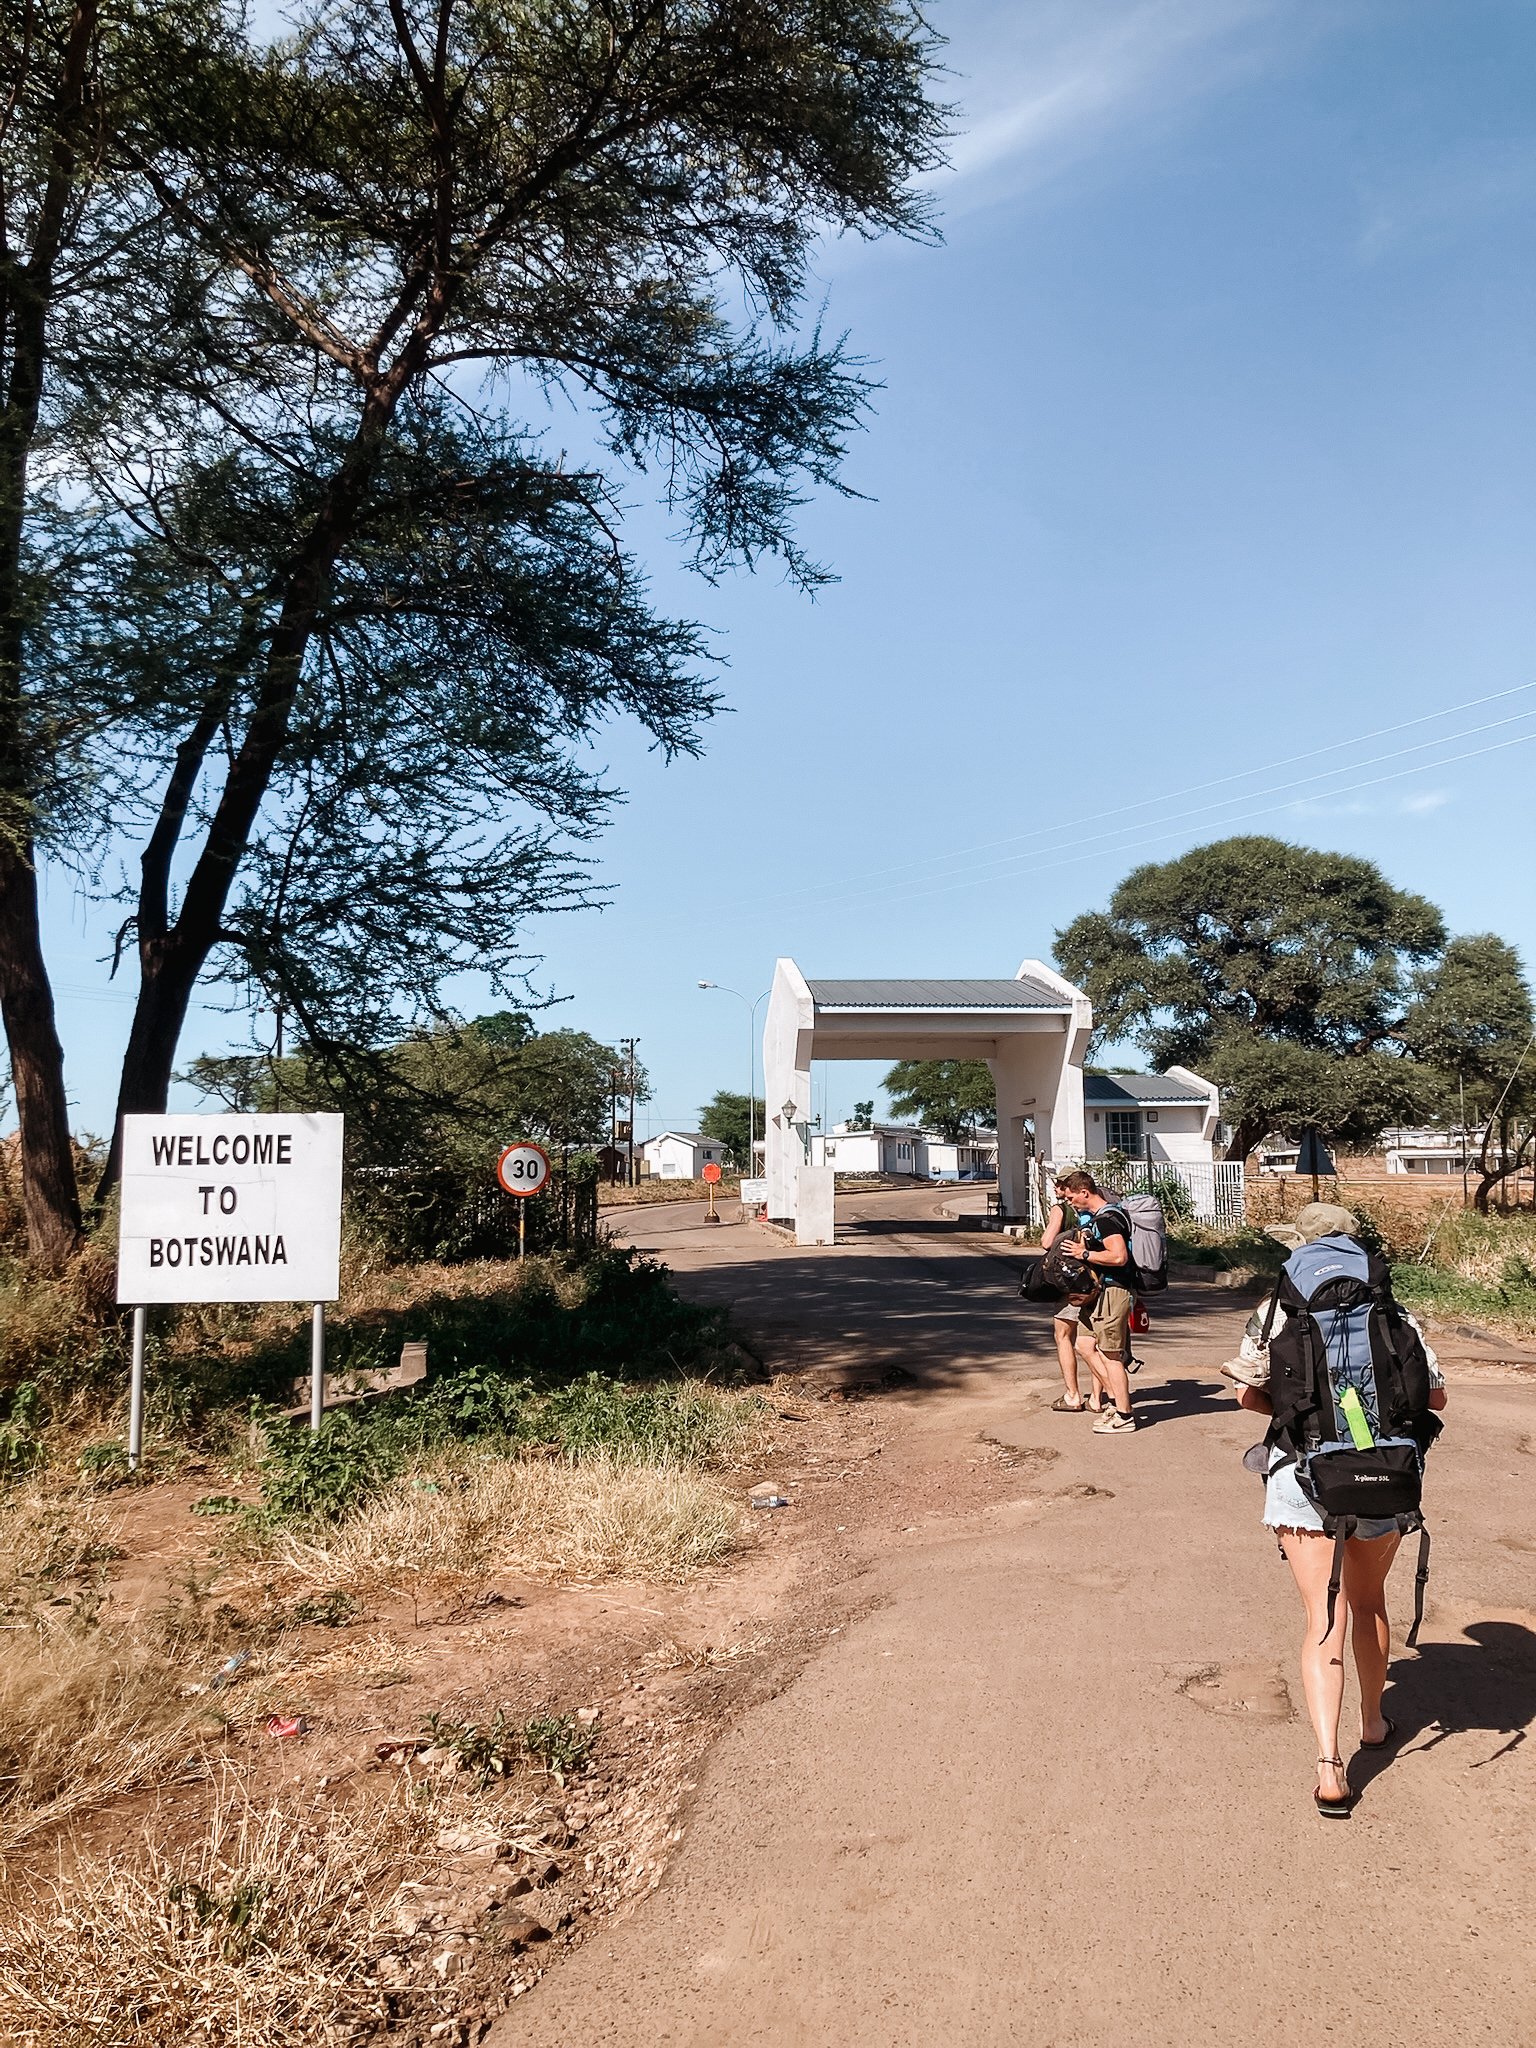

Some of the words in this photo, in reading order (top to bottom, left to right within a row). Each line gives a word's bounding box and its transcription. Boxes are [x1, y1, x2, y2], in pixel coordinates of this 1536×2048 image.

[153, 1135, 292, 1166] WELCOME
[512, 1159, 538, 1179] 30
[199, 1186, 237, 1215] TO
[150, 1235, 288, 1267] BOTSWANA
